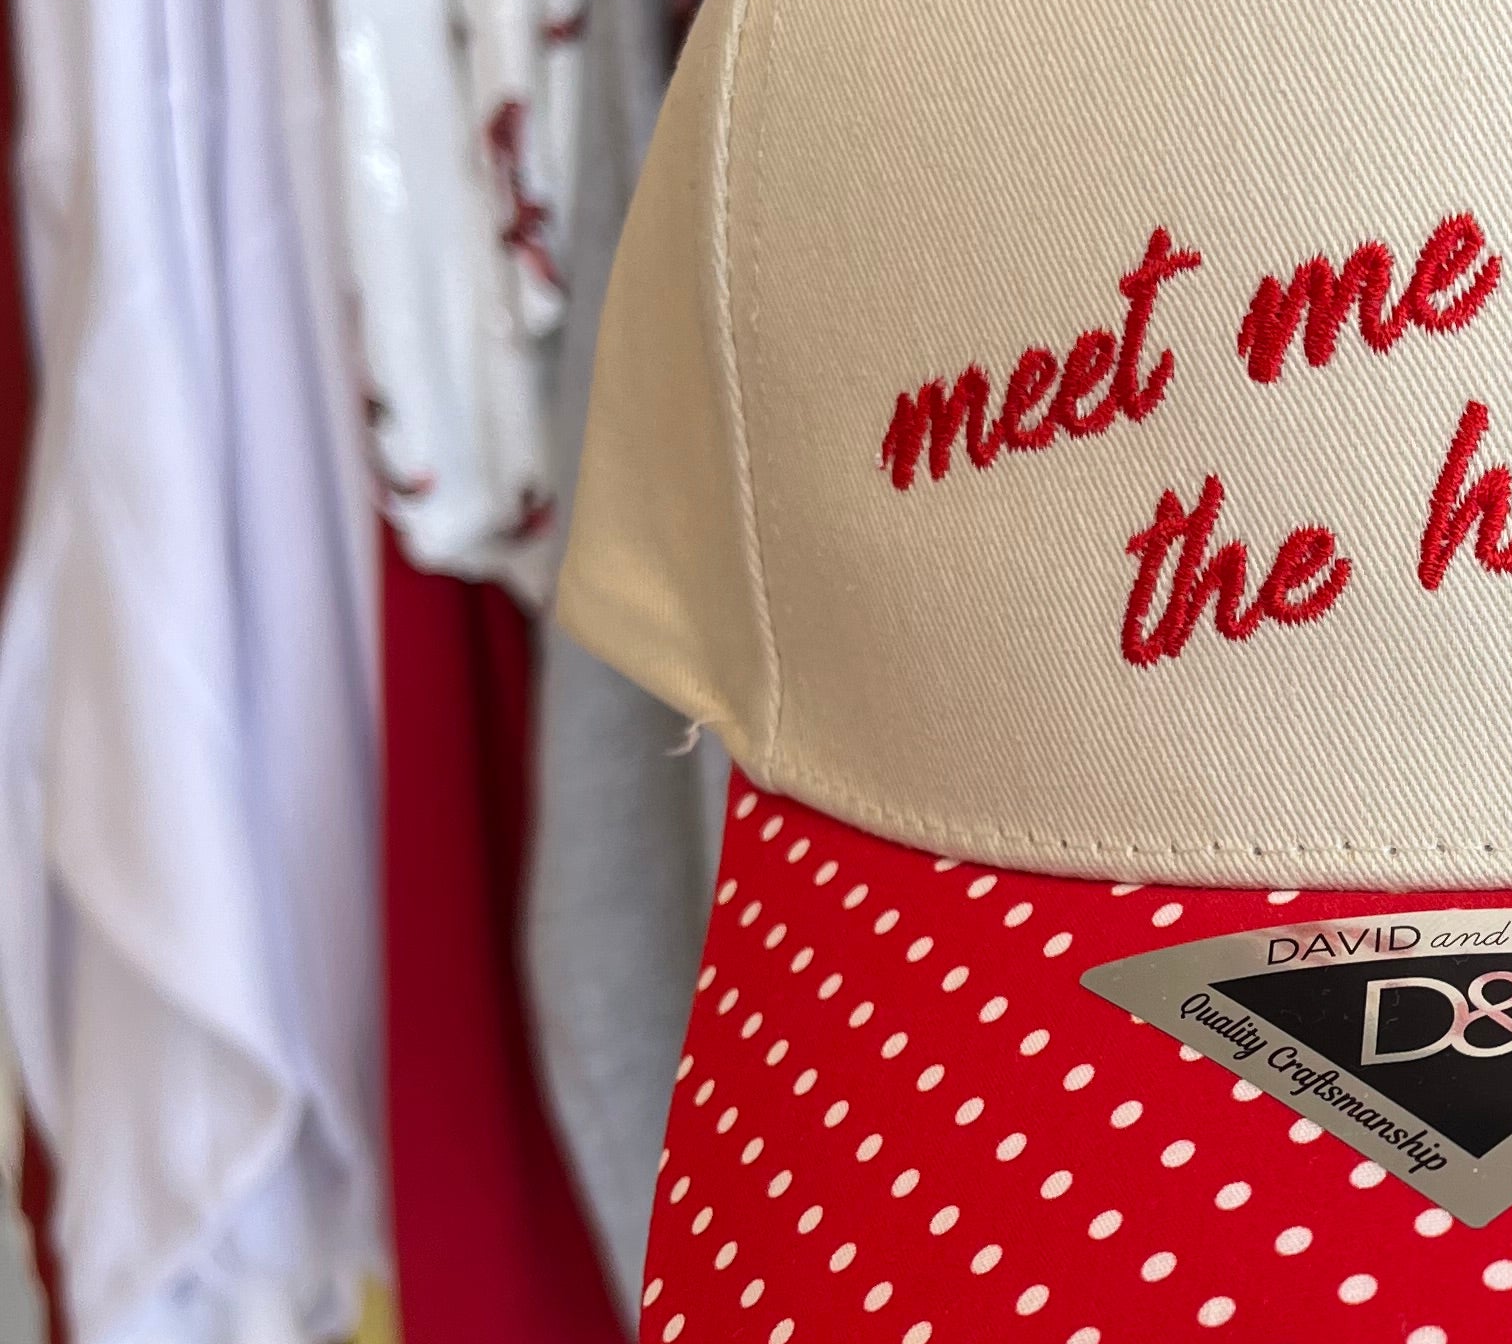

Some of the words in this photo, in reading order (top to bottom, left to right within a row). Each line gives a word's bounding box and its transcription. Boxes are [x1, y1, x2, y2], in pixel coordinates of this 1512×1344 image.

[881, 227, 1202, 491] meet
[1237, 213, 1502, 384] me
[1122, 475, 1351, 668] the
[1267, 923, 1422, 965] DAVID
[1430, 921, 1512, 949] and
[1180, 992, 1267, 1060] Quality
[1267, 1045, 1448, 1174] Craftsmanship
